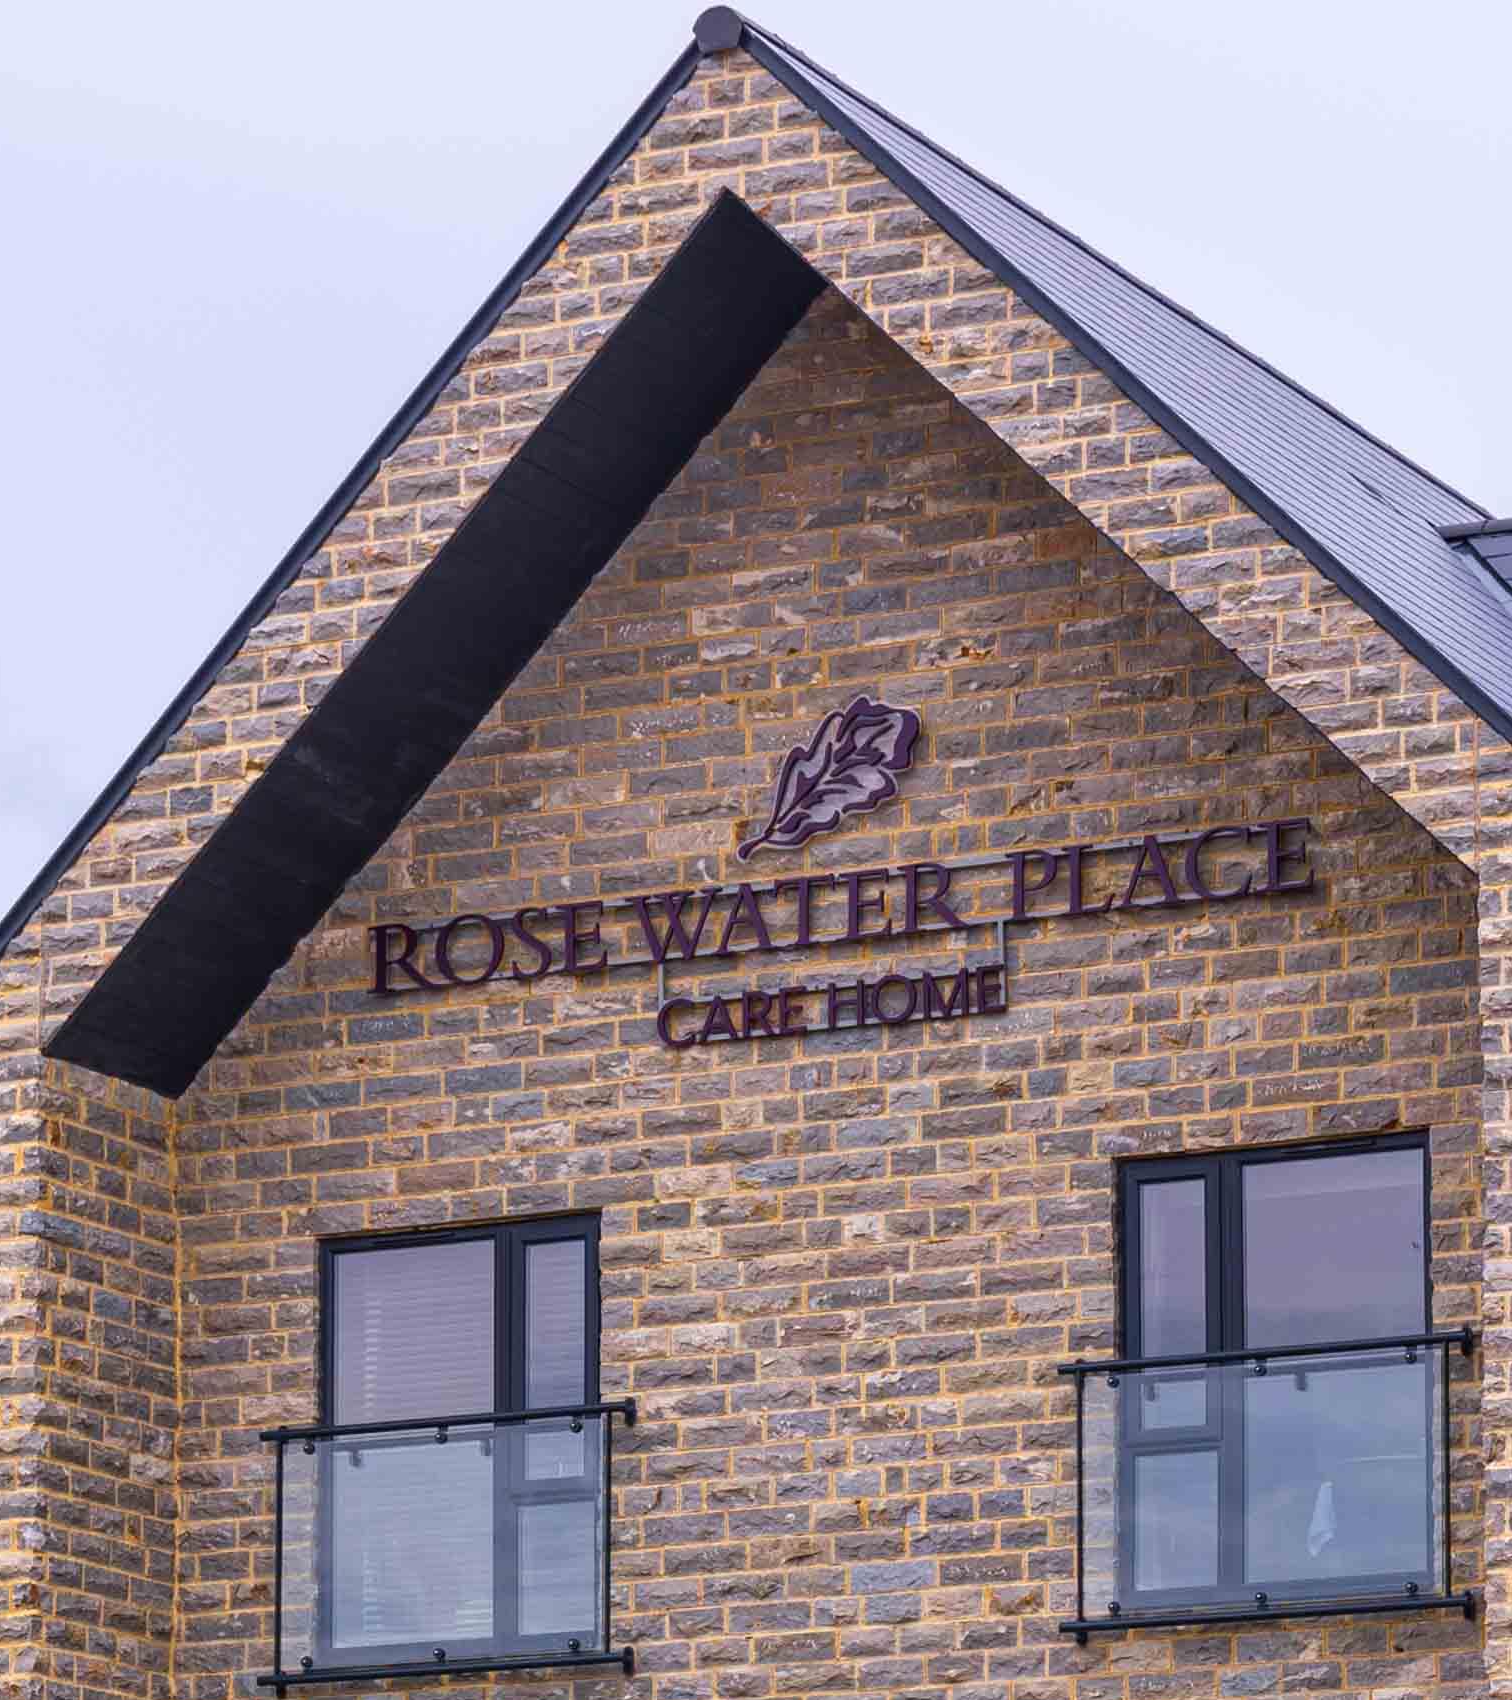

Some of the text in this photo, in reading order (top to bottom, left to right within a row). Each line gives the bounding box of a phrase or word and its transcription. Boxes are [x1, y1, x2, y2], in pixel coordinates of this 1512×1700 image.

[368, 817, 1316, 994] ROSE WATER PLACE
[656, 963, 1011, 1051] CARE HOME
